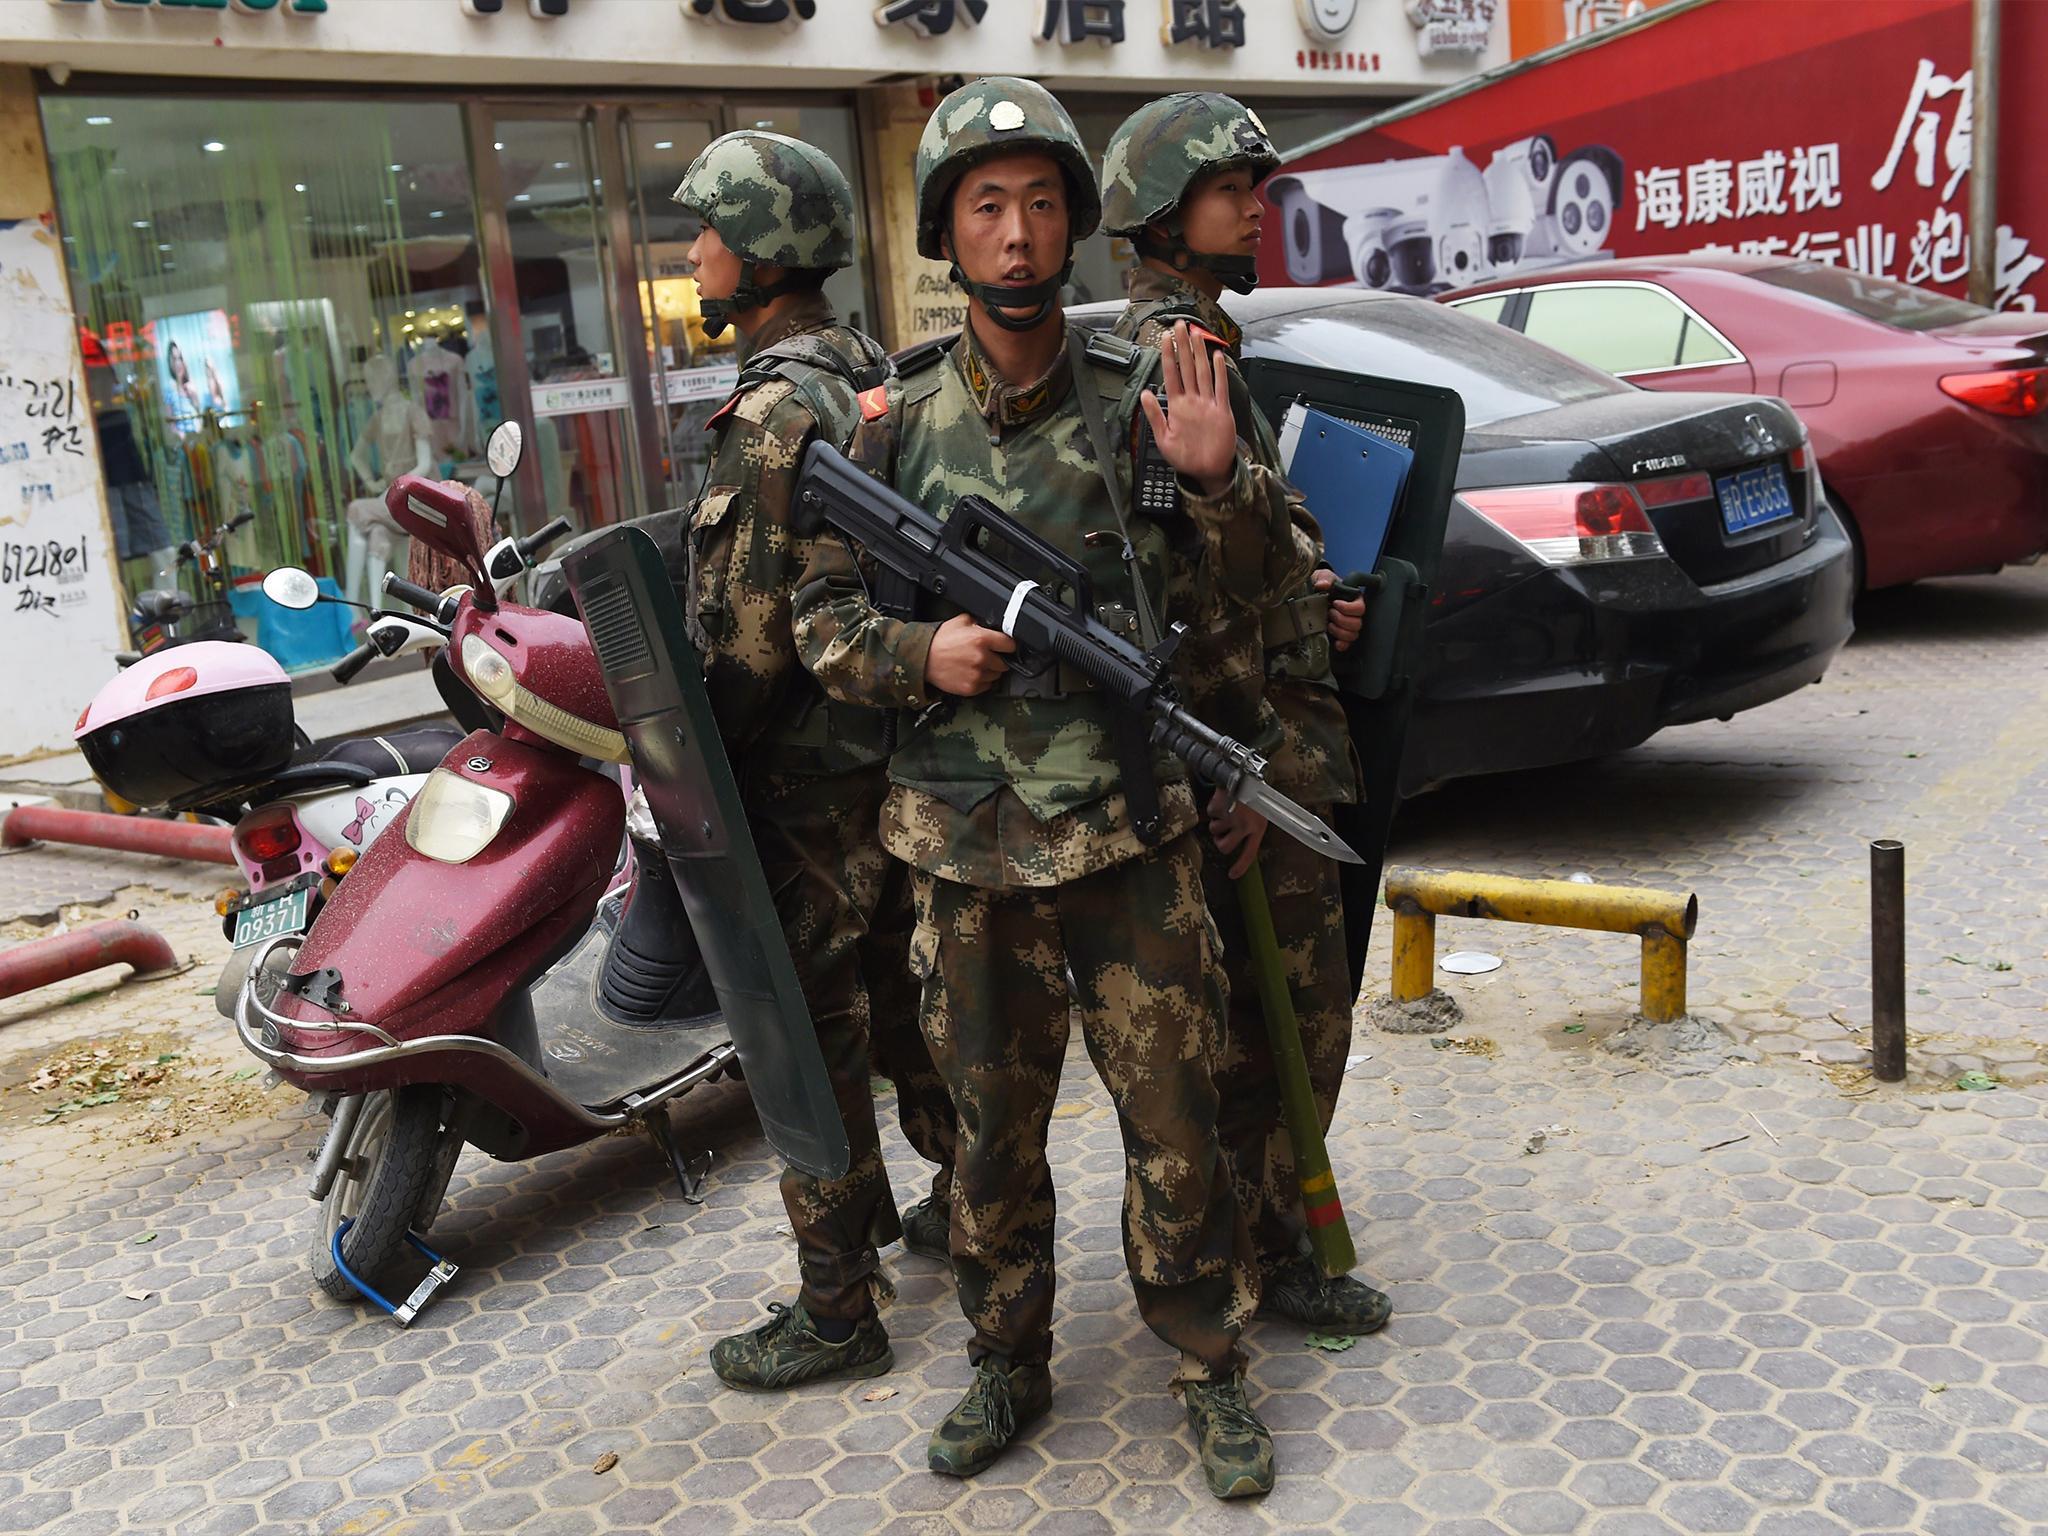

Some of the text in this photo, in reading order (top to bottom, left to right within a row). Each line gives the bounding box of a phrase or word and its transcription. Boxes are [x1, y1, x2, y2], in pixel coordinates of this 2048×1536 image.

[1634, 143, 1842, 231] 海康威视
[1687, 223, 1898, 282] 行业
[2, 534, 88, 584] 6921801
[239, 905, 297, 944] 09371
